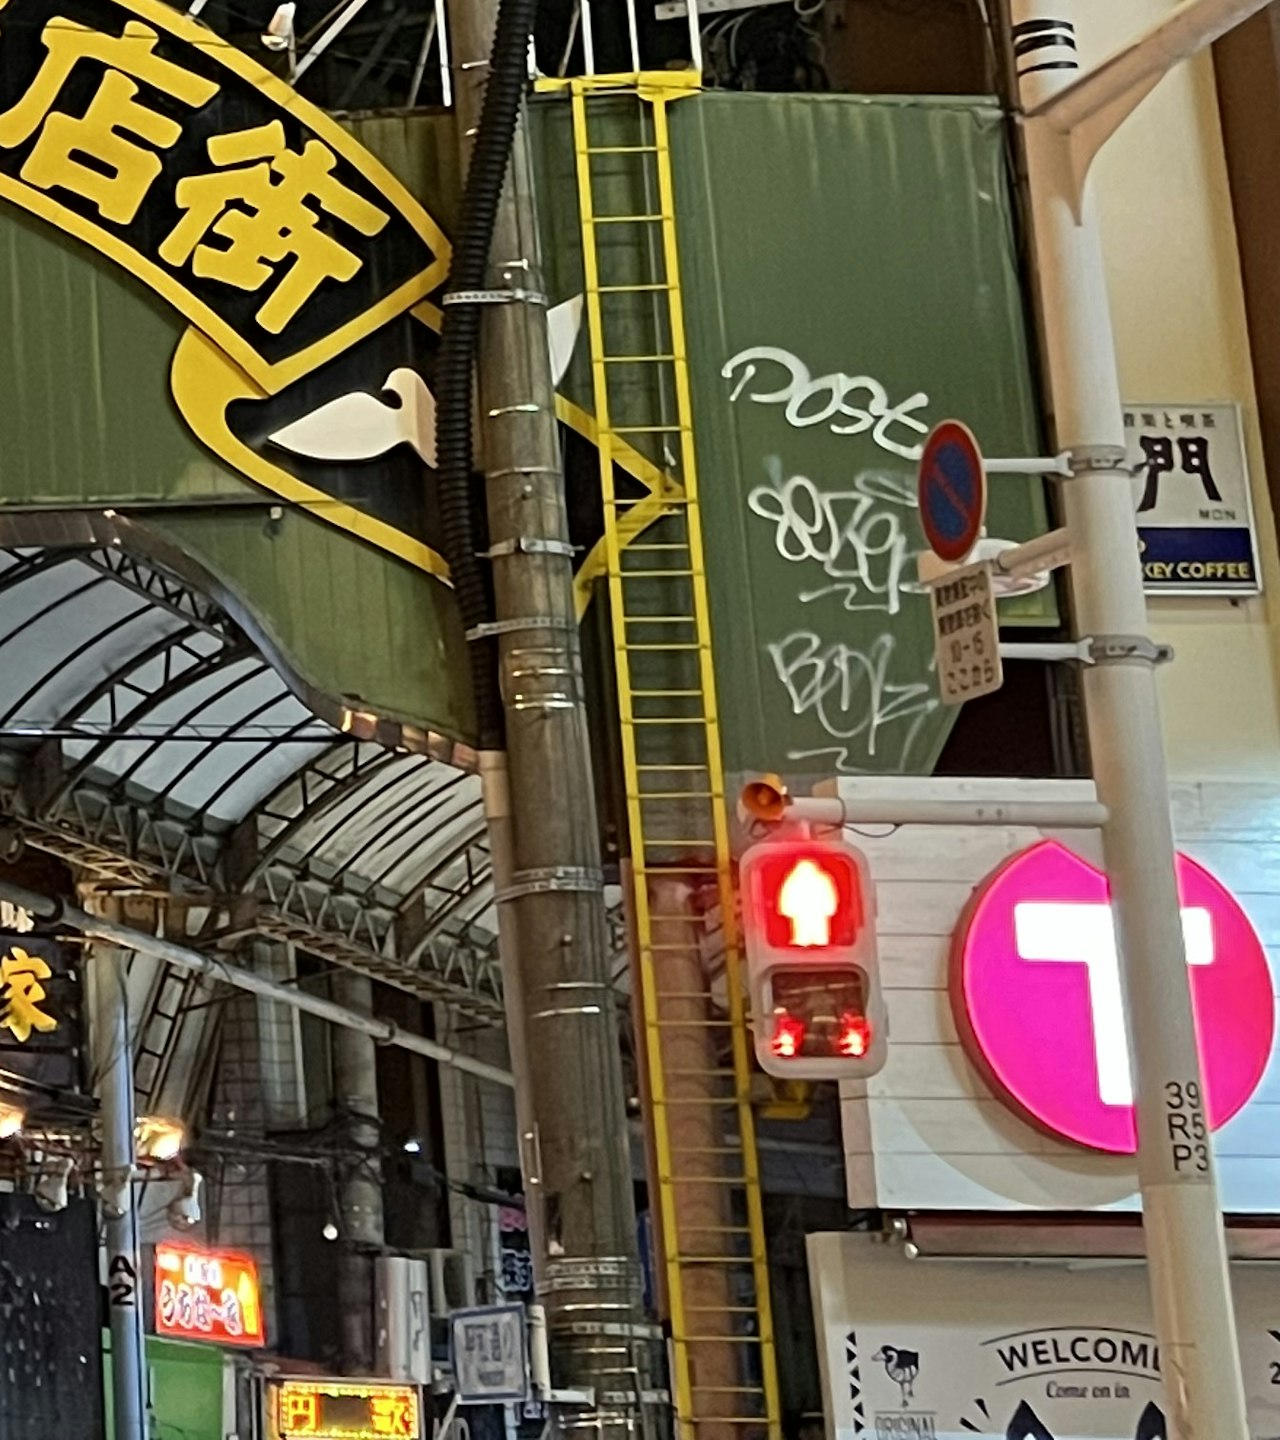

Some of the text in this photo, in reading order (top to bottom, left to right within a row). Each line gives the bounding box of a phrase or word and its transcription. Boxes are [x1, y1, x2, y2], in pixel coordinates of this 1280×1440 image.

[1136, 435, 1223, 513] 門
[1198, 508, 1236, 522] MON
[1176, 561, 1251, 579] COFFEE
[1163, 1081, 1201, 1110] 39
[1167, 1113, 1207, 1141] R5
[1172, 1143, 1210, 1172] P3
[1045, 1380, 1130, 1398] Come on in
